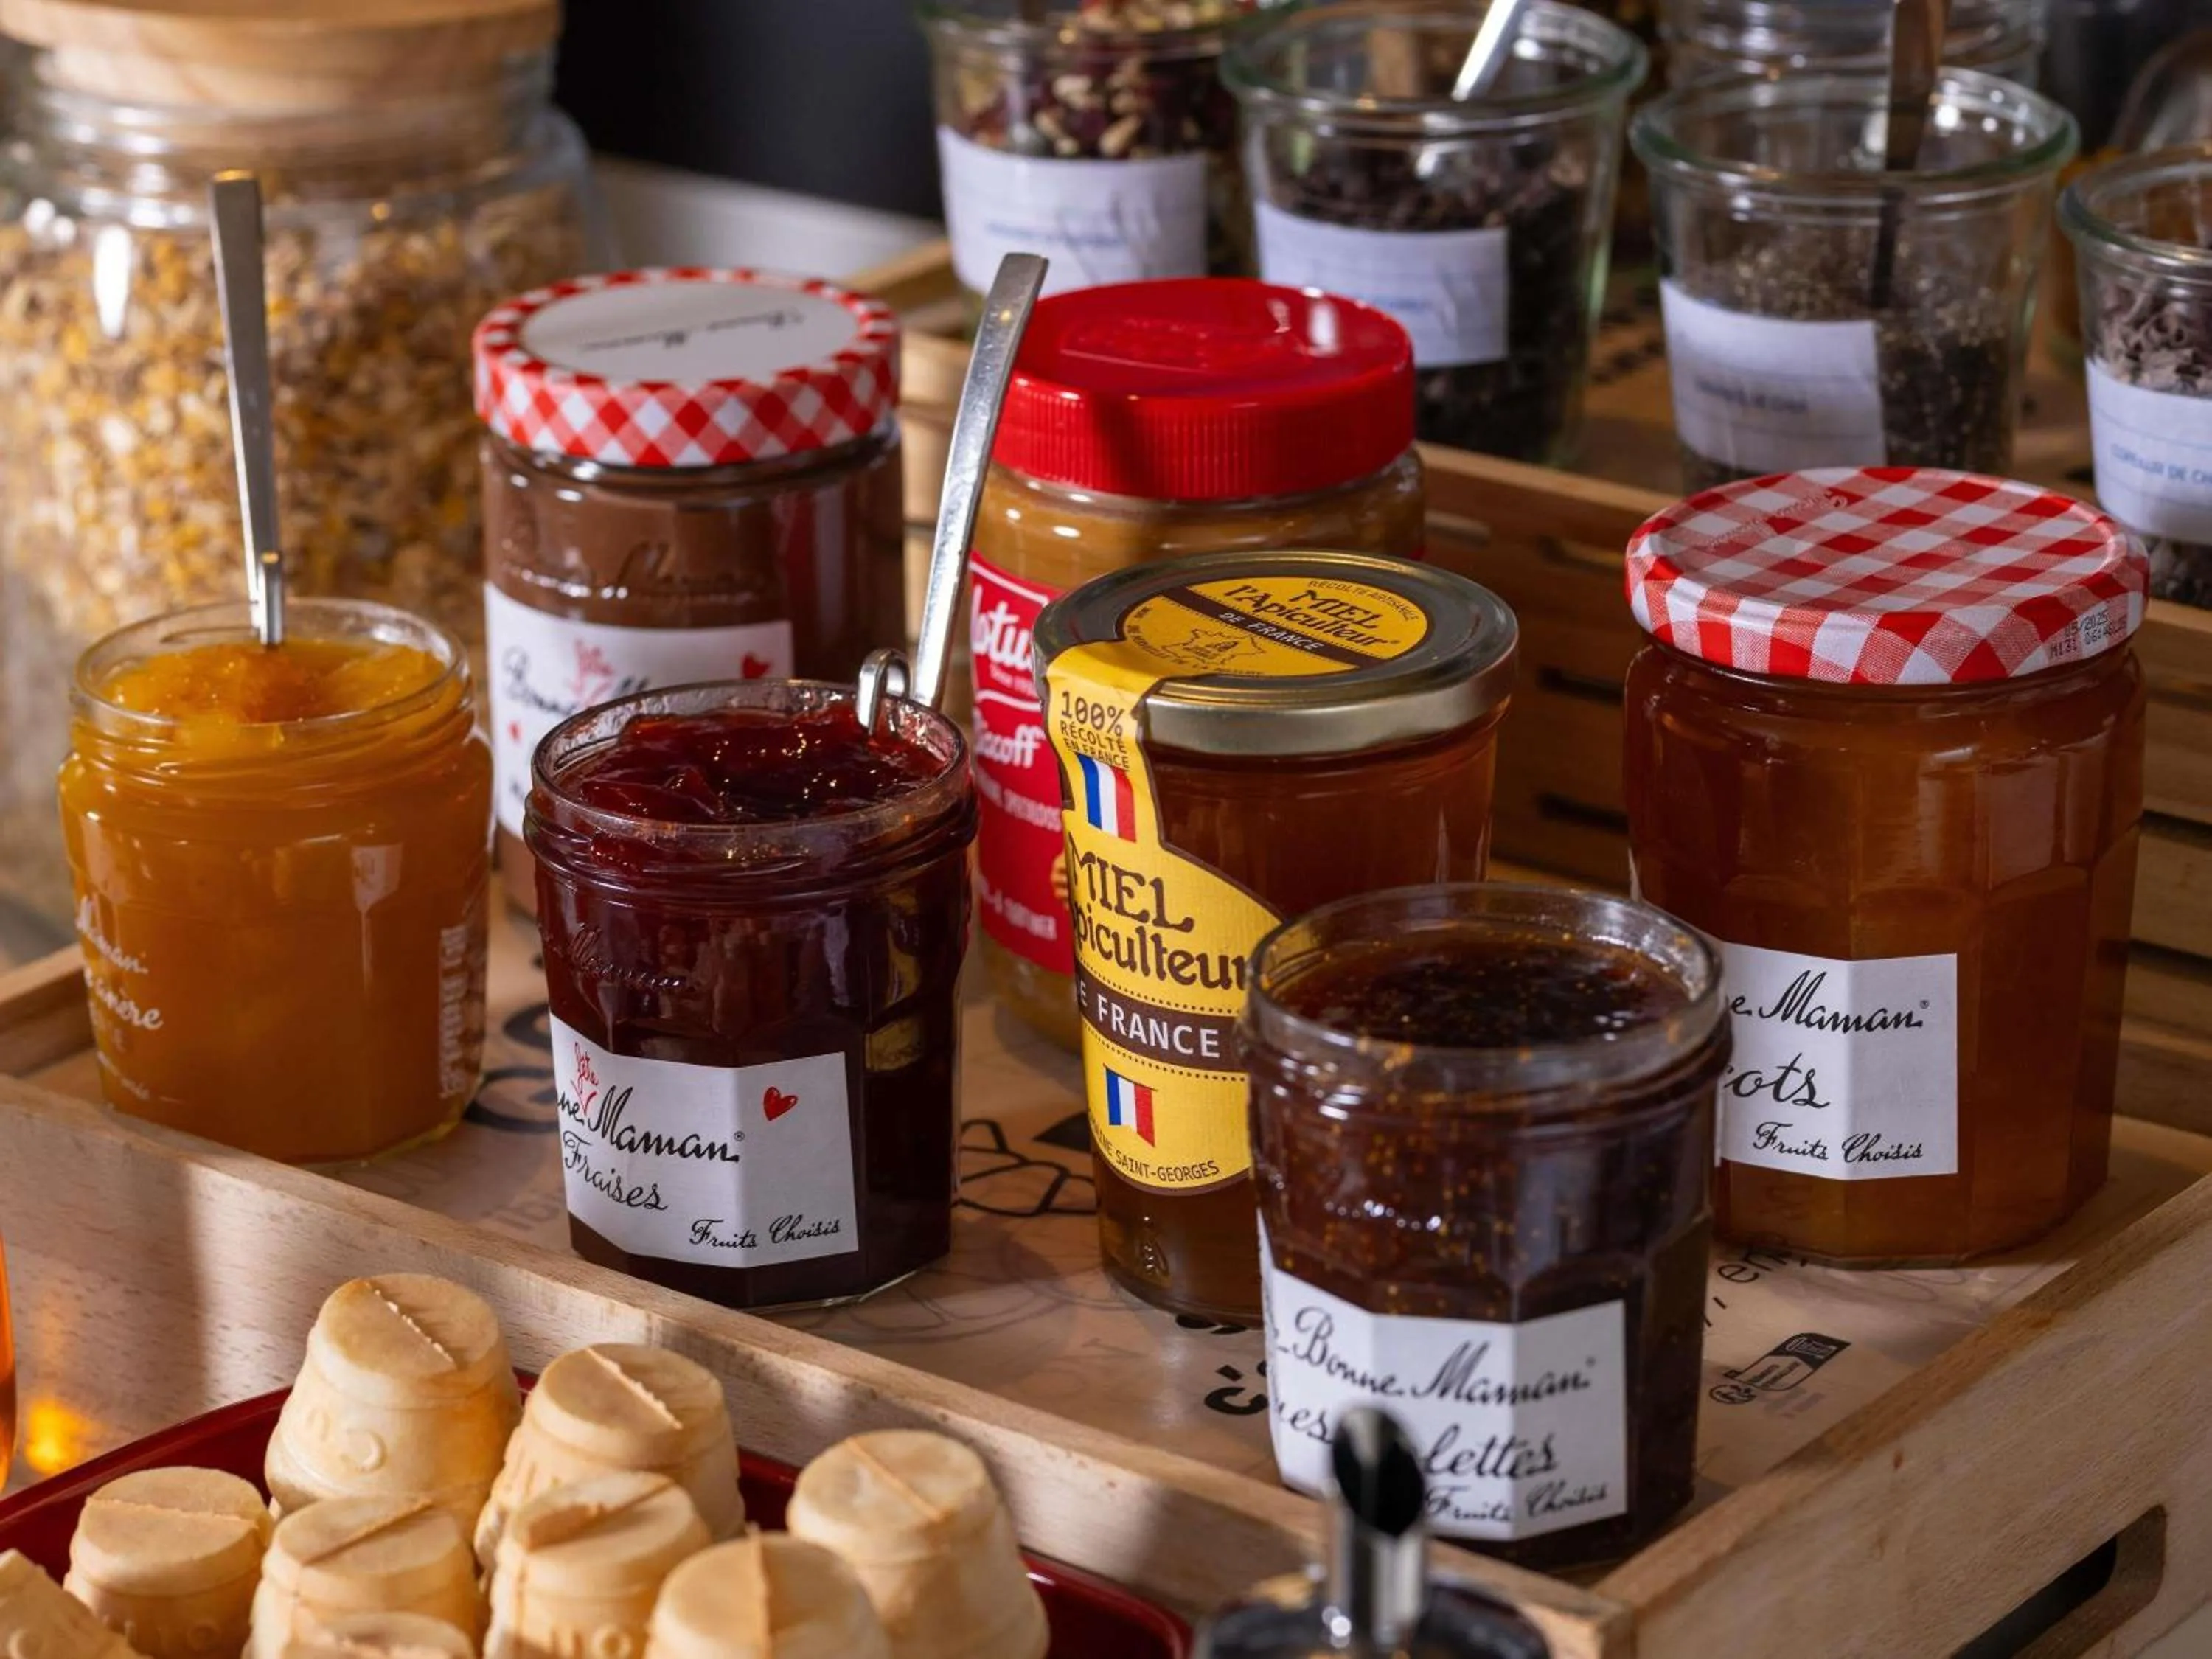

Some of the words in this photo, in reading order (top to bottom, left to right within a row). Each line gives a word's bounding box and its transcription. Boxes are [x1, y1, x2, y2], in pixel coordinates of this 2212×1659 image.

[1219, 612, 1245, 623] DE
[1248, 622, 1325, 650] FRANCE
[1289, 589, 1382, 629] MIEL
[1061, 690, 1125, 737] 100%
[1063, 737, 1080, 752] EN
[1082, 743, 1130, 770] FRANCE
[1068, 832, 1194, 933] MIEL
[1097, 992, 1221, 1059] FRANCE
[1752, 1121, 1829, 1161] Fruits
[1841, 1133, 1924, 1164] Choisis
[563, 1130, 668, 1211] Fraises
[1115, 1149, 1220, 1183] SAINT-GEORGES
[689, 1218, 758, 1248] Fruits
[768, 1214, 841, 1245] Choisis
[1293, 1306, 1405, 1396] Bonne
[1427, 1484, 1515, 1523] Fruits
[1526, 1478, 1610, 1518] Choisis
